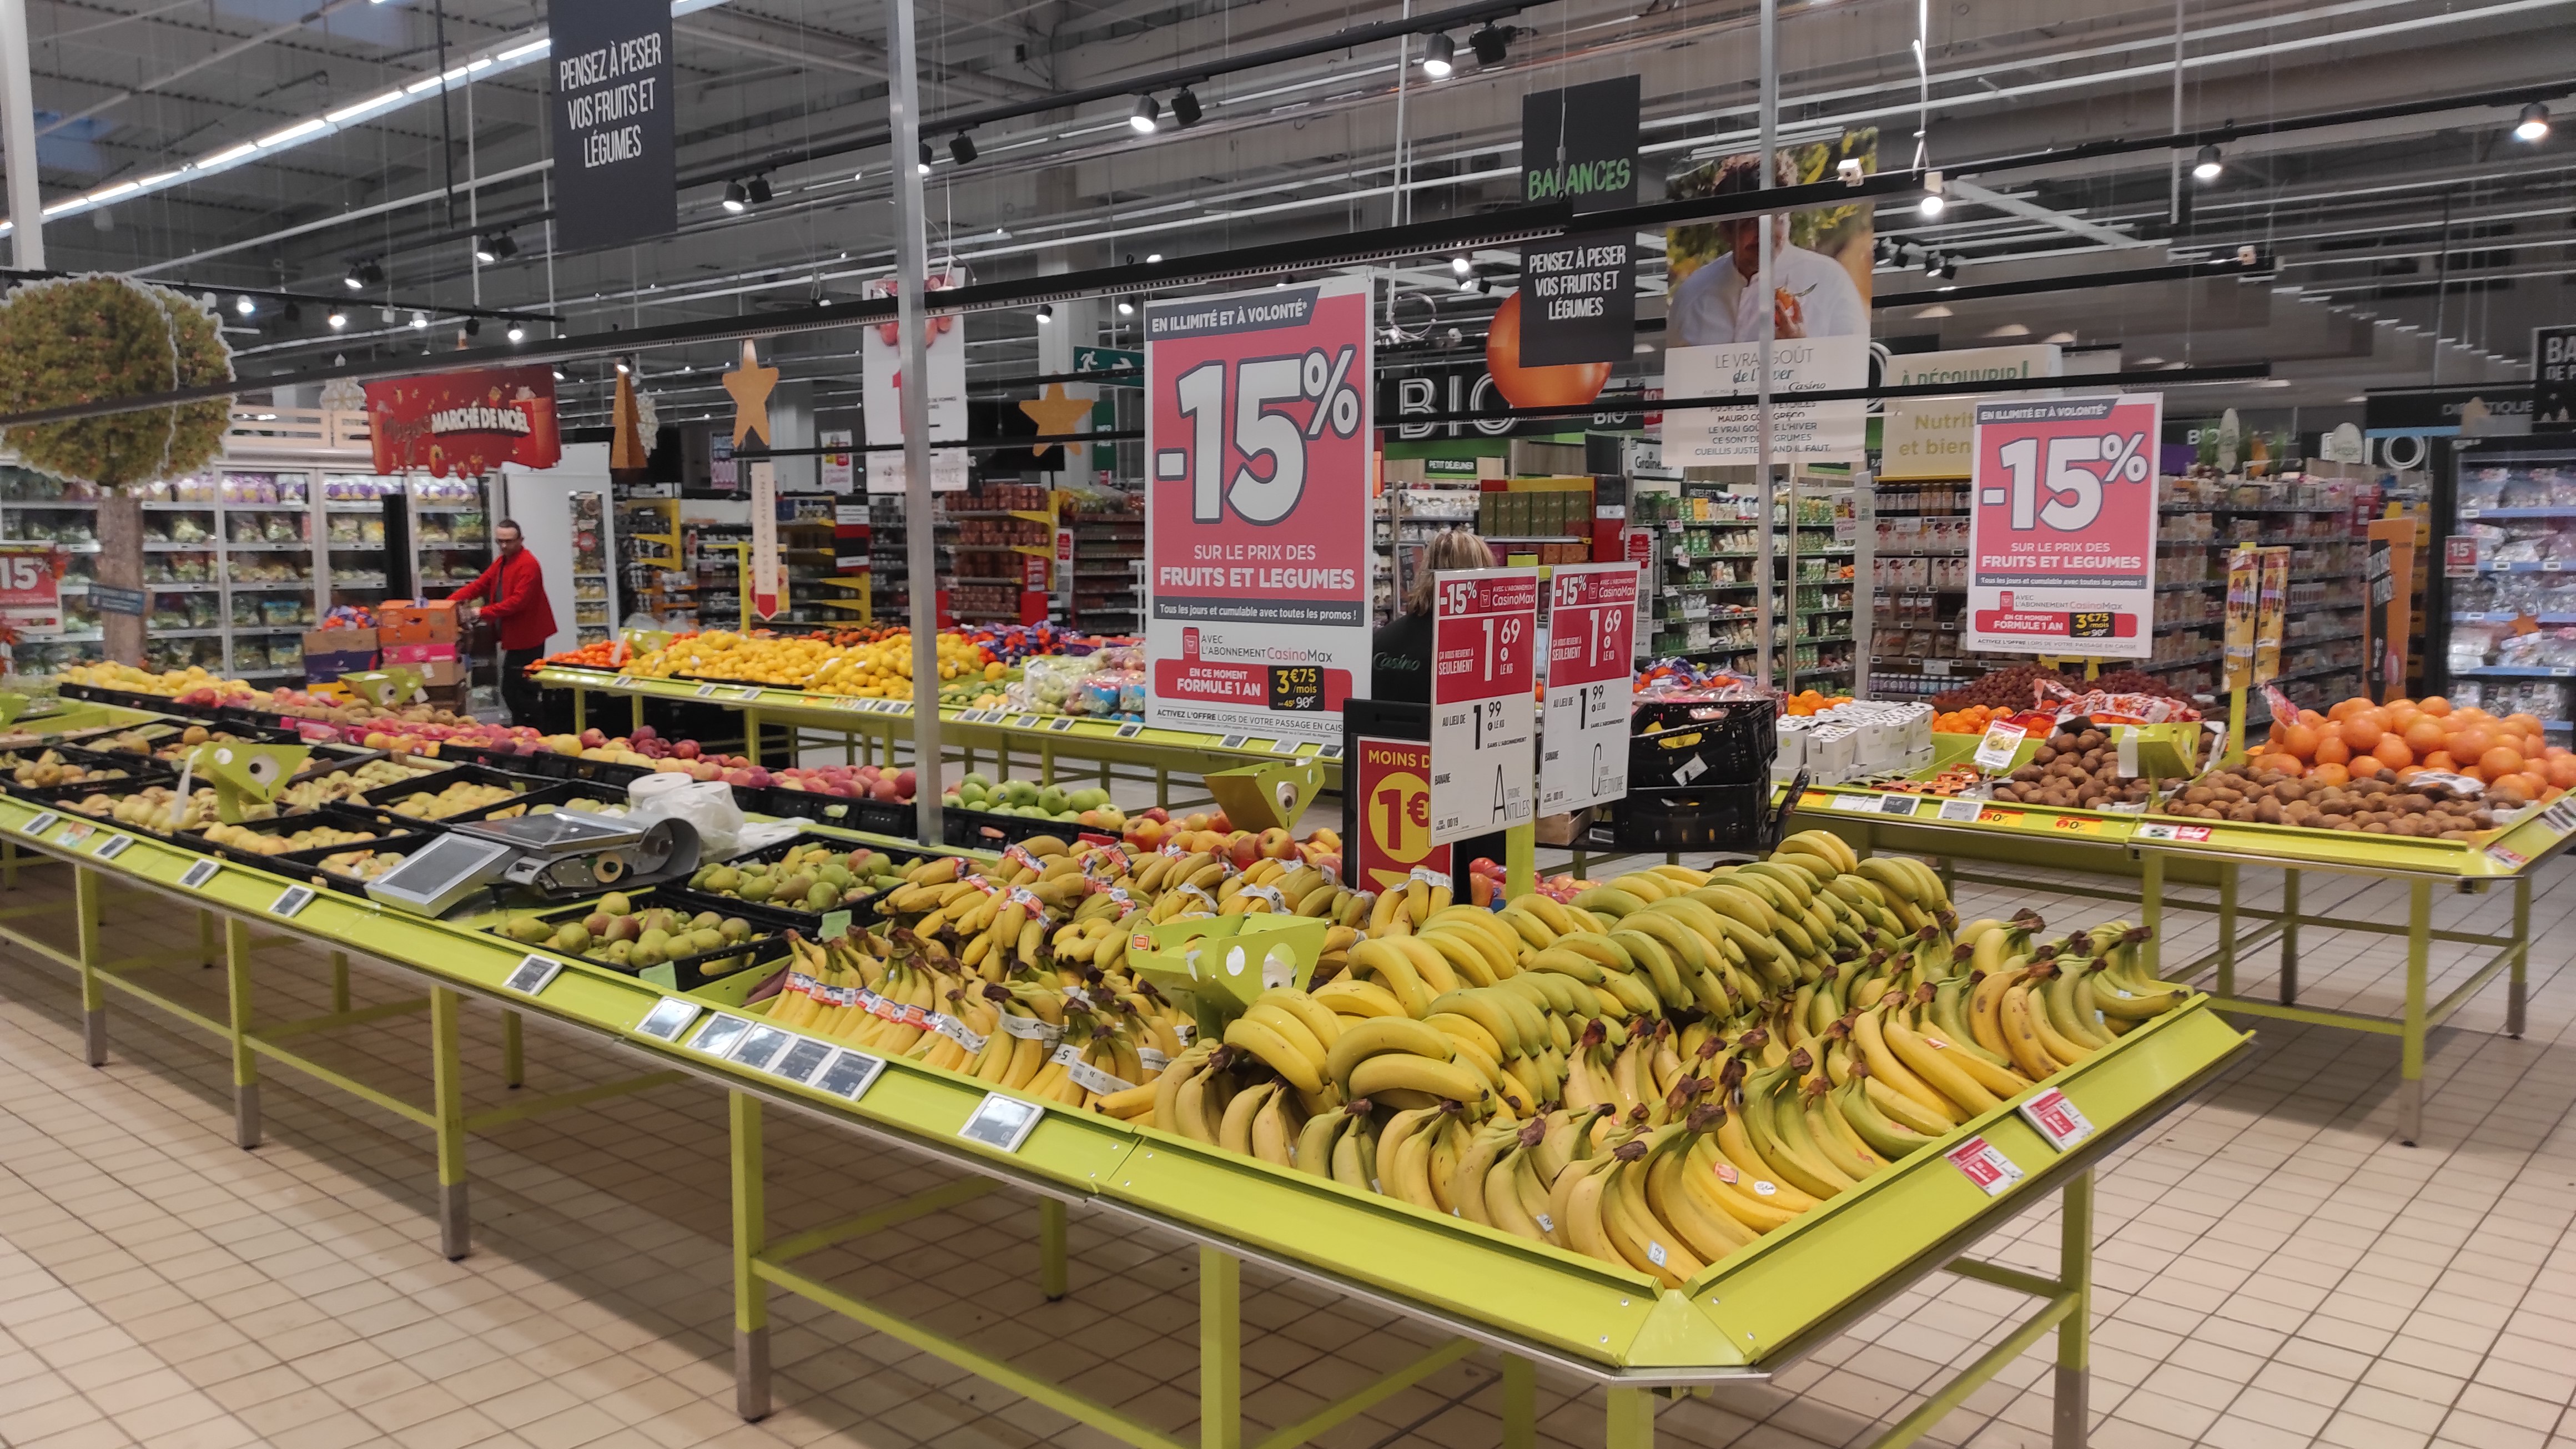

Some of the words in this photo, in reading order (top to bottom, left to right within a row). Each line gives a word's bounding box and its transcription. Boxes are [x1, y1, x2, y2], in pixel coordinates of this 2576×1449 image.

[560, 49, 607, 92] PENSEZ
[610, 40, 620, 78] À
[621, 32, 662, 76] PESER
[568, 95, 593, 130] VOS
[595, 83, 638, 124] FRUITS
[640, 77, 656, 113] ET
[584, 124, 642, 168] LÉGUMES
[1529, 250, 1574, 273] PENSEZ
[1576, 246, 1585, 269] À
[1587, 245, 1626, 268] PESER
[1535, 276, 1559, 298] VOS
[1561, 271, 1602, 294] FRUITS
[1603, 270, 1619, 290] ET
[1548, 296, 1604, 320] LÉGUMES
[1152, 317, 1168, 333] EN
[1170, 309, 1217, 331] ILLIMITÉ
[1220, 310, 1235, 326] ET
[1236, 305, 1246, 324] À
[1715, 354, 1729, 368] LE
[1733, 353, 1762, 368] VRA
[1789, 381, 1826, 392] Casino
[1399, 373, 1518, 439] BIO
[1980, 411, 1994, 420] EN
[1995, 407, 2033, 419] ILLIMITÉ
[2034, 408, 2047, 418] ET
[2047, 406, 2056, 416] À
[431, 401, 481, 434] MARCHÉ
[481, 407, 497, 429] DE
[497, 406, 531, 433] NOËL
[1782, 422, 1817, 430] L'HIVER
[1915, 412, 1974, 430] Nutrit
[1156, 344, 1361, 526] -15%
[1899, 440, 1918, 455] et
[1981, 432, 2149, 532] -15%
[1194, 545, 1221, 560] SUR
[1226, 545, 1244, 560] LE
[1248, 545, 1281, 560] PRIX
[1286, 545, 1316, 560] DES
[2011, 542, 2034, 552] SUR
[2037, 543, 2052, 552] LE
[2055, 542, 2082, 552] PRIX
[2086, 543, 2110, 552] DES
[1981, 555, 2036, 567] FRUITS
[2040, 556, 2060, 567] ET
[2064, 556, 2141, 568] LEGUMES
[1160, 567, 1225, 587] FRUITS
[1230, 568, 1254, 587] ET
[1259, 568, 1355, 589] LEGUMES
[1440, 581, 1477, 614] -15%
[1556, 575, 1587, 605] -15%
[1599, 586, 1635, 598] CasinoMax
[1492, 592, 1534, 606] CasinoMax
[2070, 601, 2122, 610] CasinoMax
[1160, 603, 1176, 613] Tous
[1178, 605, 1188, 614] les
[1189, 605, 1208, 616] jours
[1209, 606, 1217, 615] et
[1219, 606, 1257, 617] cumulable
[1259, 608, 1278, 617] avec
[1280, 608, 1305, 618] toutes
[1306, 608, 1318, 618] les
[1320, 610, 1351, 621] promos
[1994, 620, 2040, 630] FORMULE
[2041, 622, 2046, 630] 1
[2048, 622, 2063, 631] AN
[1201, 635, 1223, 643] AVEC
[1202, 647, 1266, 657] L'ABONNEMENT
[1267, 647, 1332, 662] CasinoMax
[1373, 652, 1420, 671] Casino
[1552, 646, 1582, 661] SEULEMENT
[1190, 668, 1200, 677] EN
[1201, 669, 1212, 678] CE
[1213, 670, 1248, 680] MOMENT
[1439, 659, 1473, 675] SEULEMENT
[1177, 678, 1232, 695] FORMULE
[1235, 682, 1240, 695] 1
[1243, 683, 1261, 697] AN
[1292, 684, 1317, 693] /mois
[1593, 685, 1604, 700] 99
[1488, 701, 1501, 718] 99
[1157, 709, 1185, 718] ACTIVEZ
[1249, 717, 1274, 726] VOTRE
[1276, 719, 1310, 729] PASSAGE
[1313, 722, 1322, 730] EN
[1325, 723, 1342, 732] CAIS
[1450, 715, 1460, 726] LIEU
[1460, 714, 1466, 724] DE
[1368, 749, 1416, 767] MOINS
[1421, 754, 1430, 768] D
